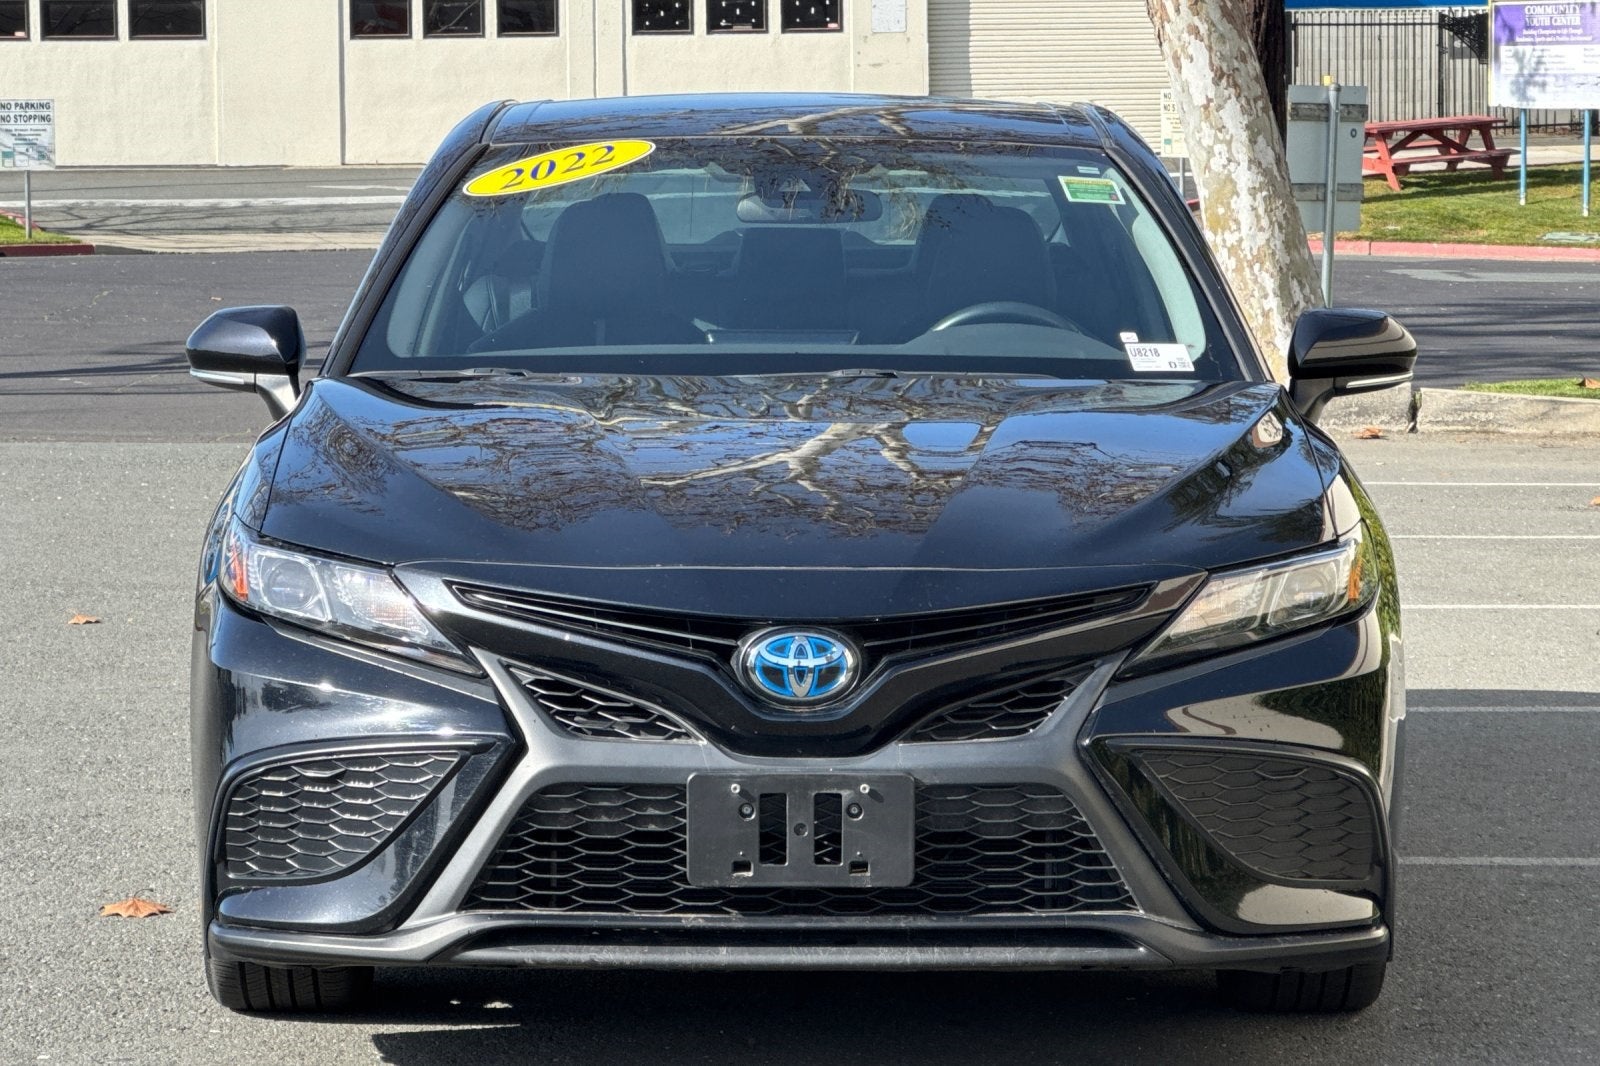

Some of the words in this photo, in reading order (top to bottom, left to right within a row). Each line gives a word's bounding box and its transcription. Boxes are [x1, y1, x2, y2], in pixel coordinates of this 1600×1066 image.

[1525, 5, 1580, 14] COMMUNITY
[1526, 17, 1550, 26] YOUTH
[1552, 17, 1581, 25] CENTER
[1164, 92, 1171, 100] NO
[0, 102, 12, 110] NO
[14, 102, 51, 110] PARKING
[0, 114, 11, 123] NO
[13, 114, 52, 123] STOPPING
[500, 145, 615, 190] 2022
[1129, 347, 1160, 358] U8218
